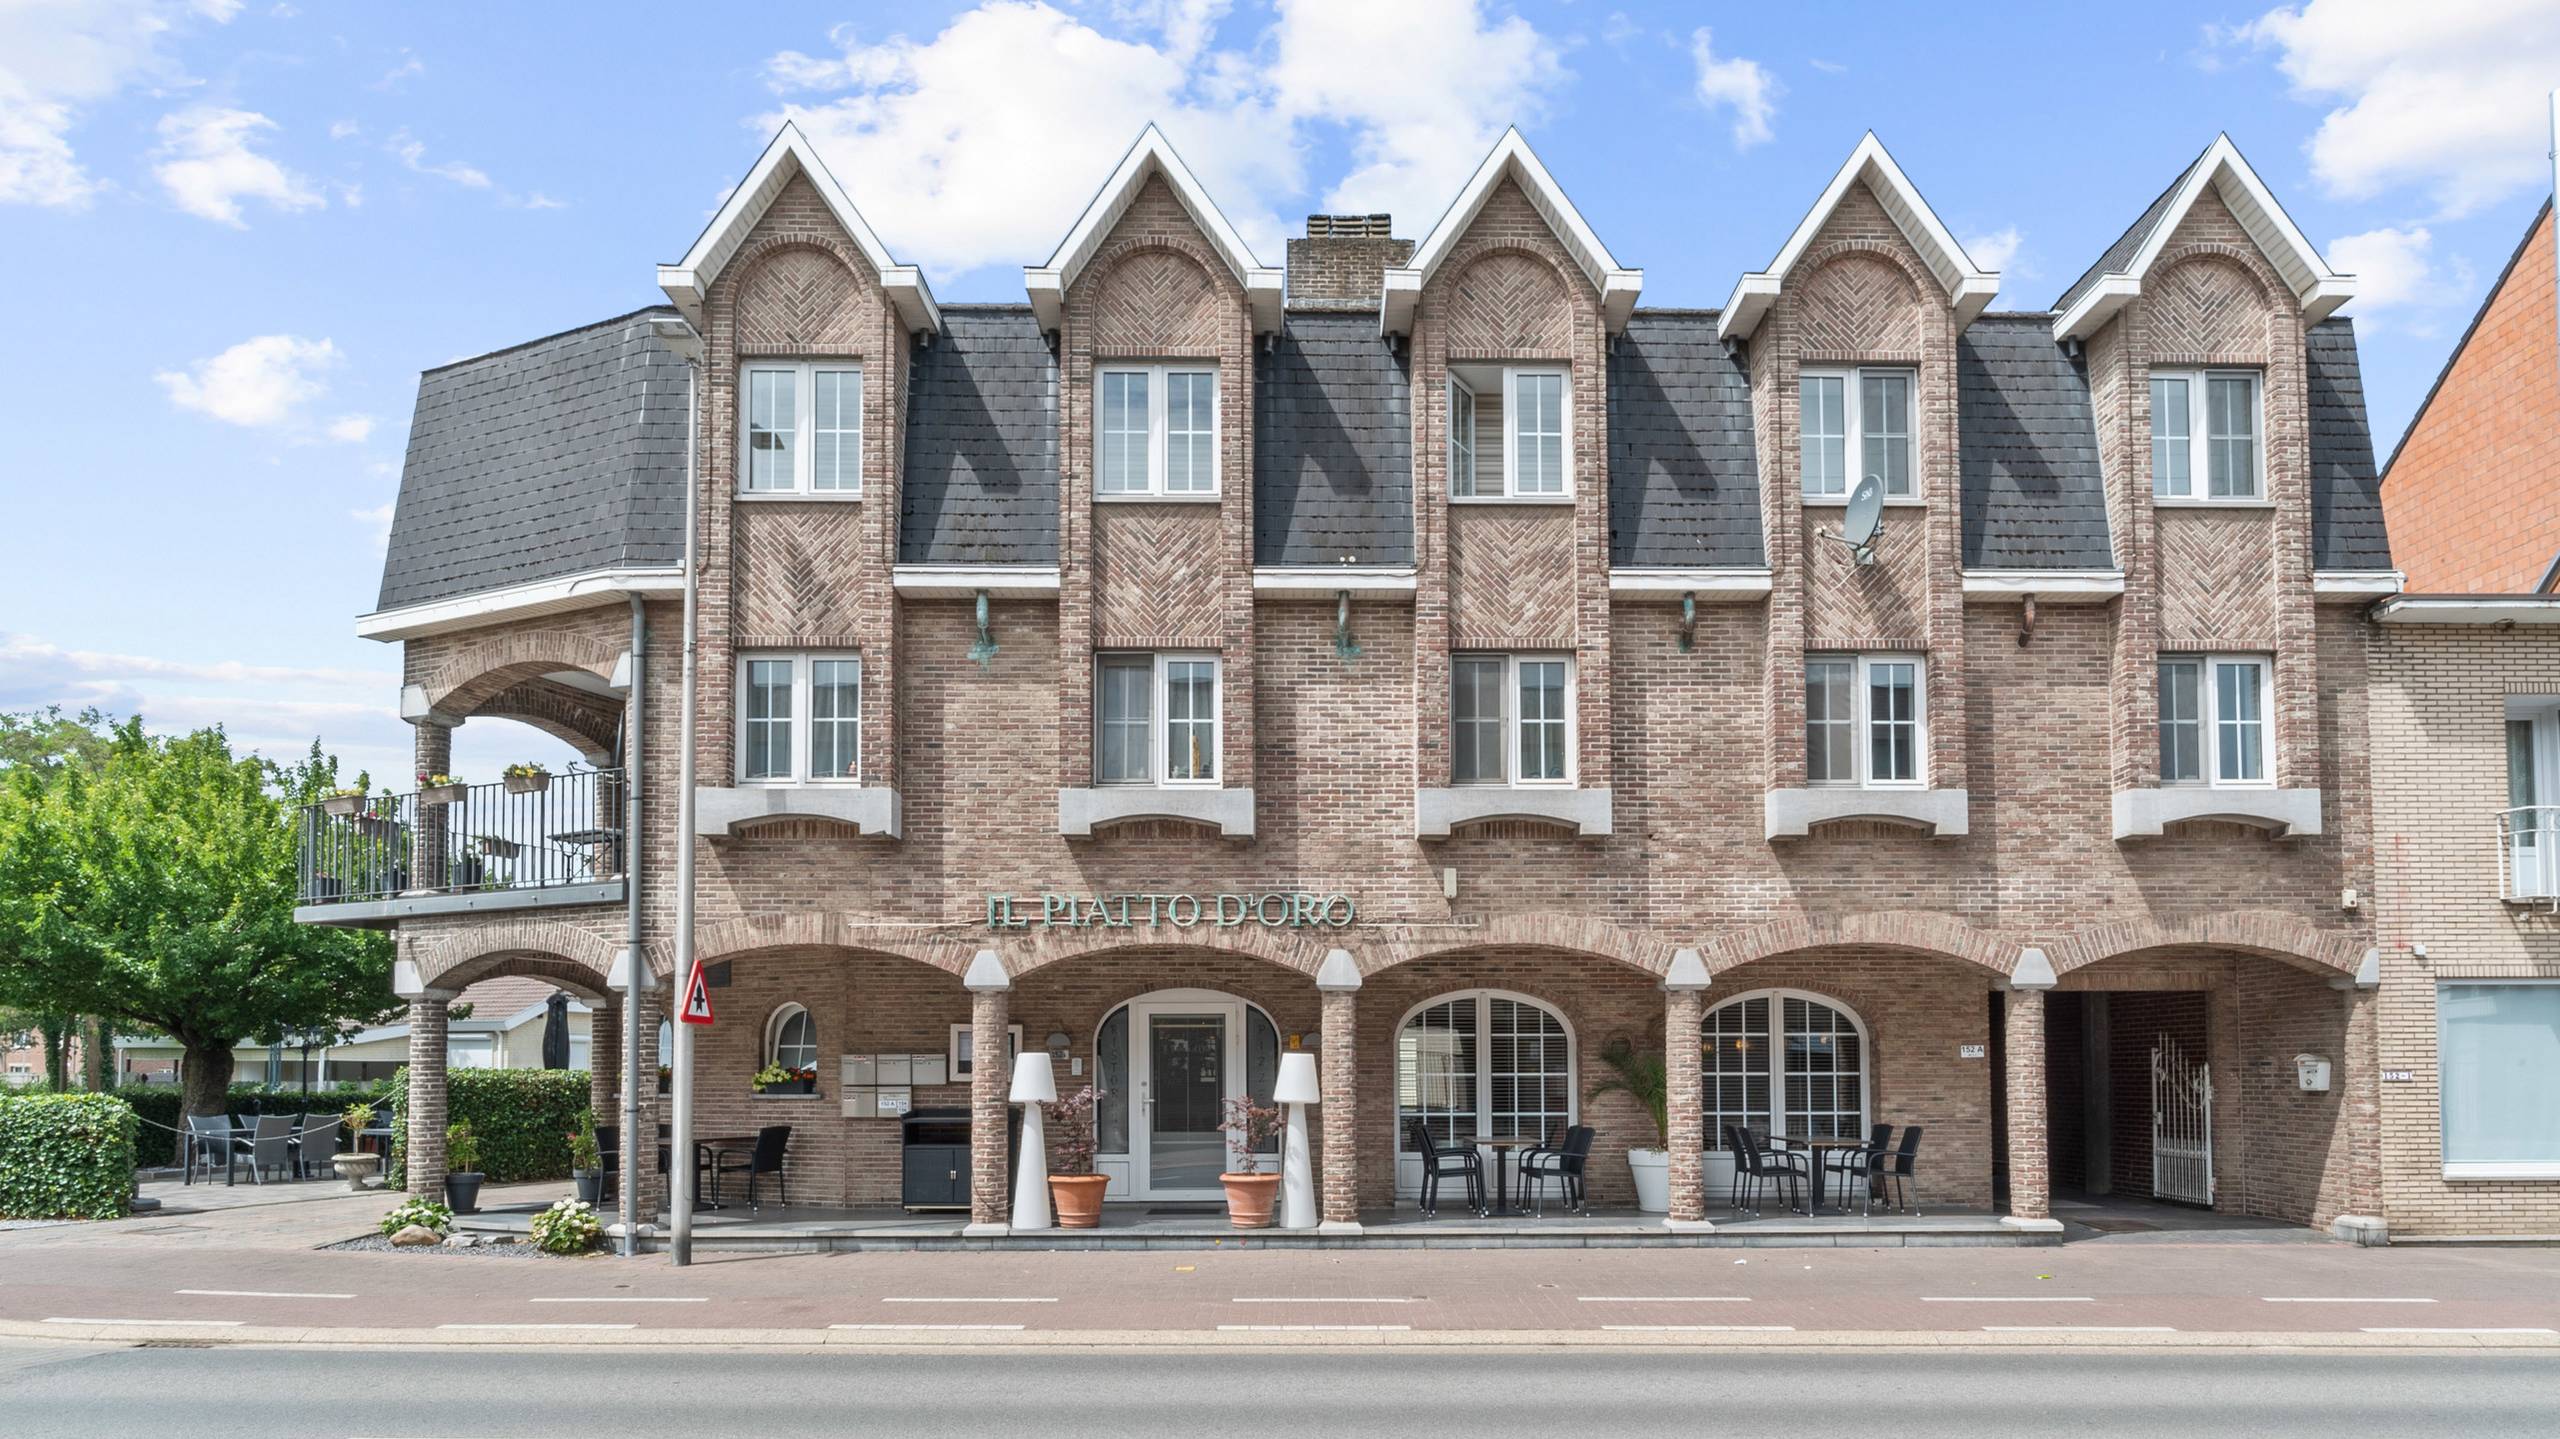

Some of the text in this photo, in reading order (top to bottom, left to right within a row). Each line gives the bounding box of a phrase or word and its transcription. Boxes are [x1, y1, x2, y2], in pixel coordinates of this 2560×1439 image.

[986, 892, 1355, 928] IL PIATTO D'ORO
